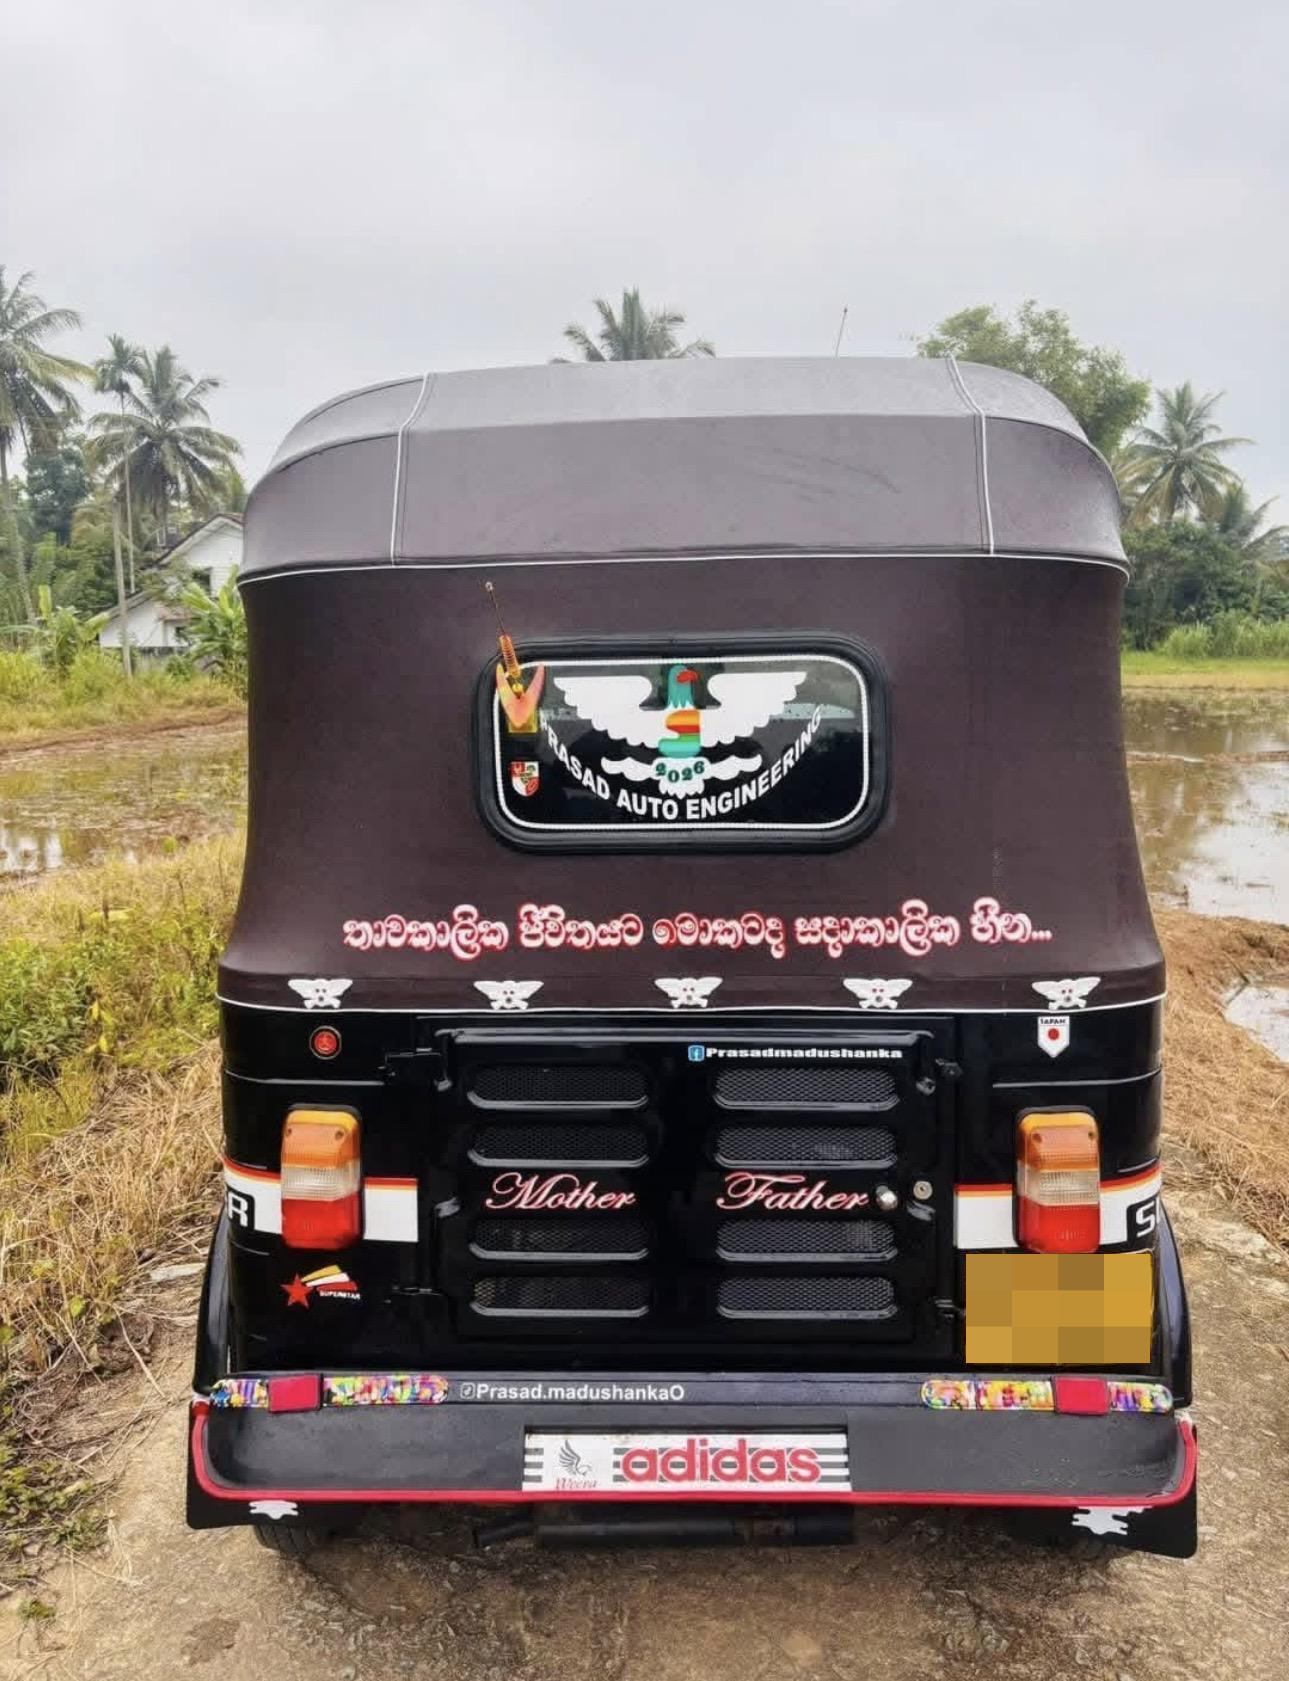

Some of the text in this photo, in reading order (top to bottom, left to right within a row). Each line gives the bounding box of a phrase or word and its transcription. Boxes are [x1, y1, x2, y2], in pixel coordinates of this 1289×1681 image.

[616, 789, 678, 820] AUTO
[686, 704, 823, 820] ENGINEERING
[655, 761, 705, 783] 2026
[343, 904, 509, 961] තාවකාලික
[652, 911, 786, 959] මොකටද
[793, 899, 961, 958] සදාකාලික
[706, 1048, 903, 1059] Prasadmadushanka
[485, 1171, 869, 1211] Mother Father
[1135, 1196, 1160, 1238] S
[622, 1438, 822, 1482] adidas
